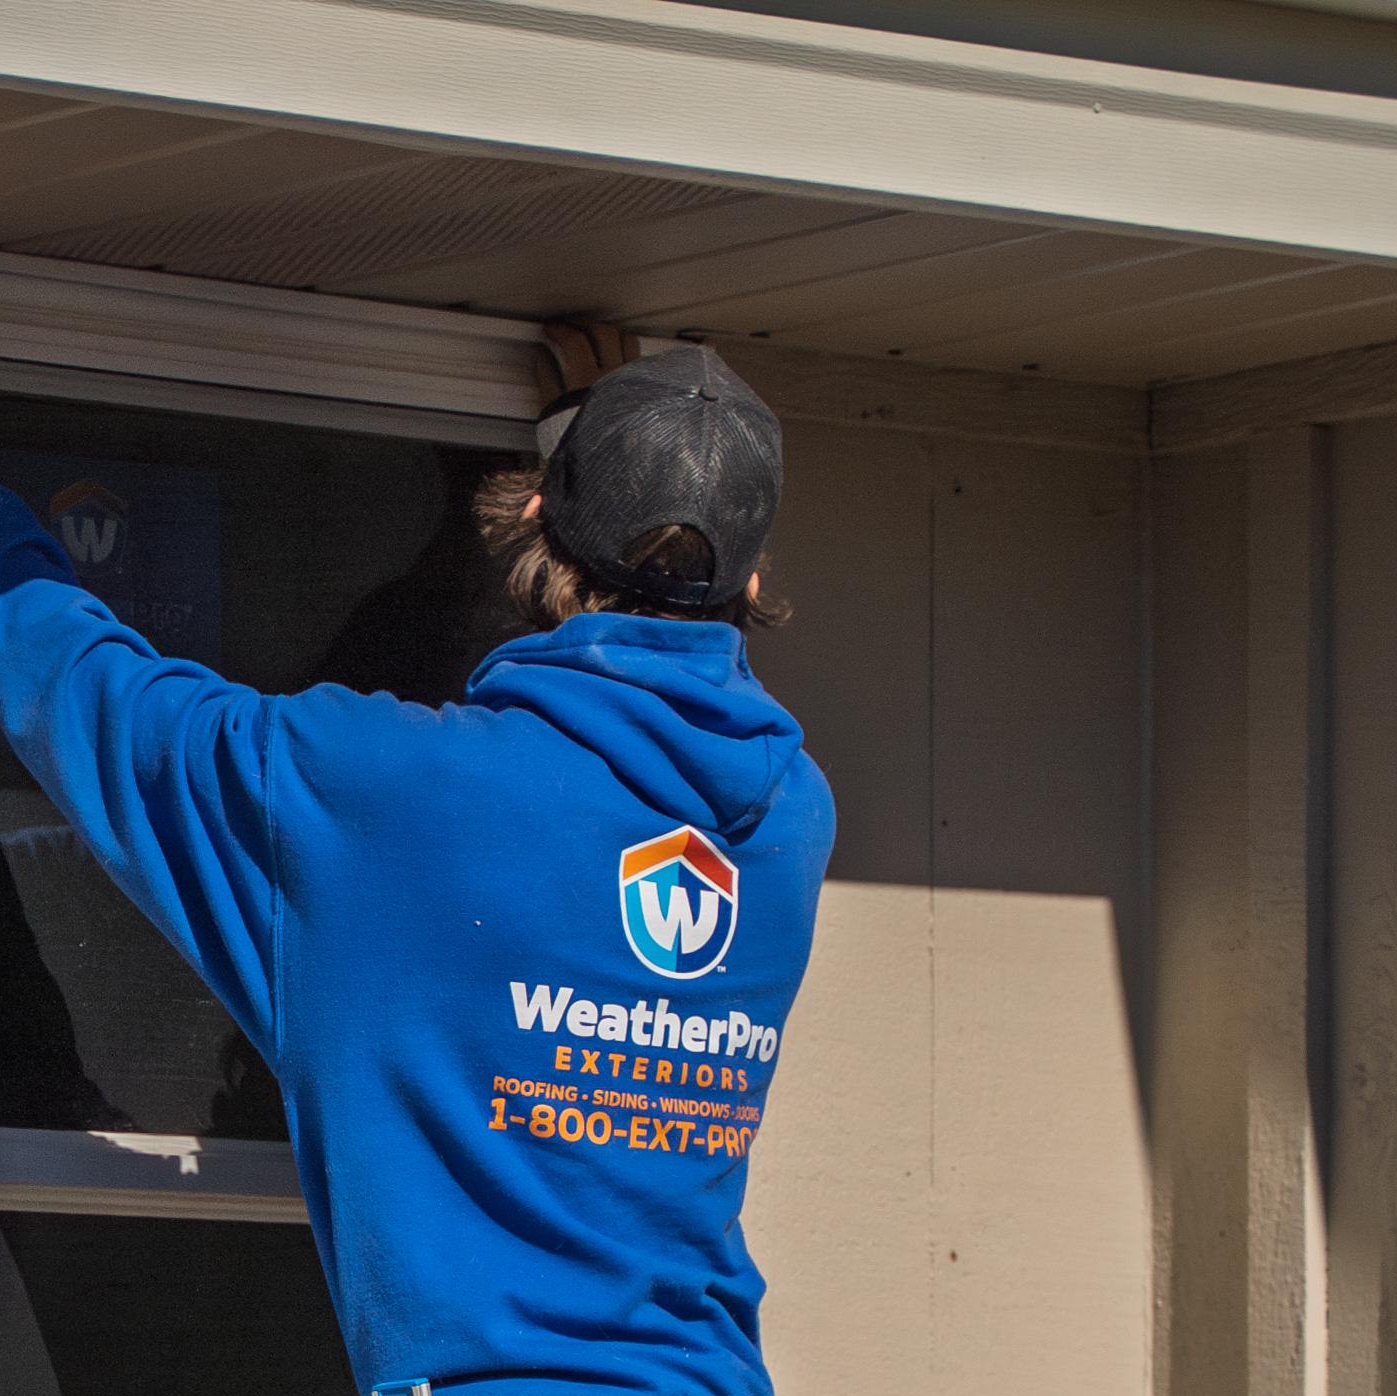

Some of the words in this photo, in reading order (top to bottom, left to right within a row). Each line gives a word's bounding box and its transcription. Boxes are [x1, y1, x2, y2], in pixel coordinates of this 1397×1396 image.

[60, 514, 118, 563] W
[638, 879, 719, 954] W
[509, 981, 778, 1063] WeatherPro
[555, 1045, 748, 1092] EXTERIORS
[493, 1075, 578, 1101] ROOFING
[592, 1088, 649, 1110] SIDING
[660, 1096, 730, 1118] WINDOWS
